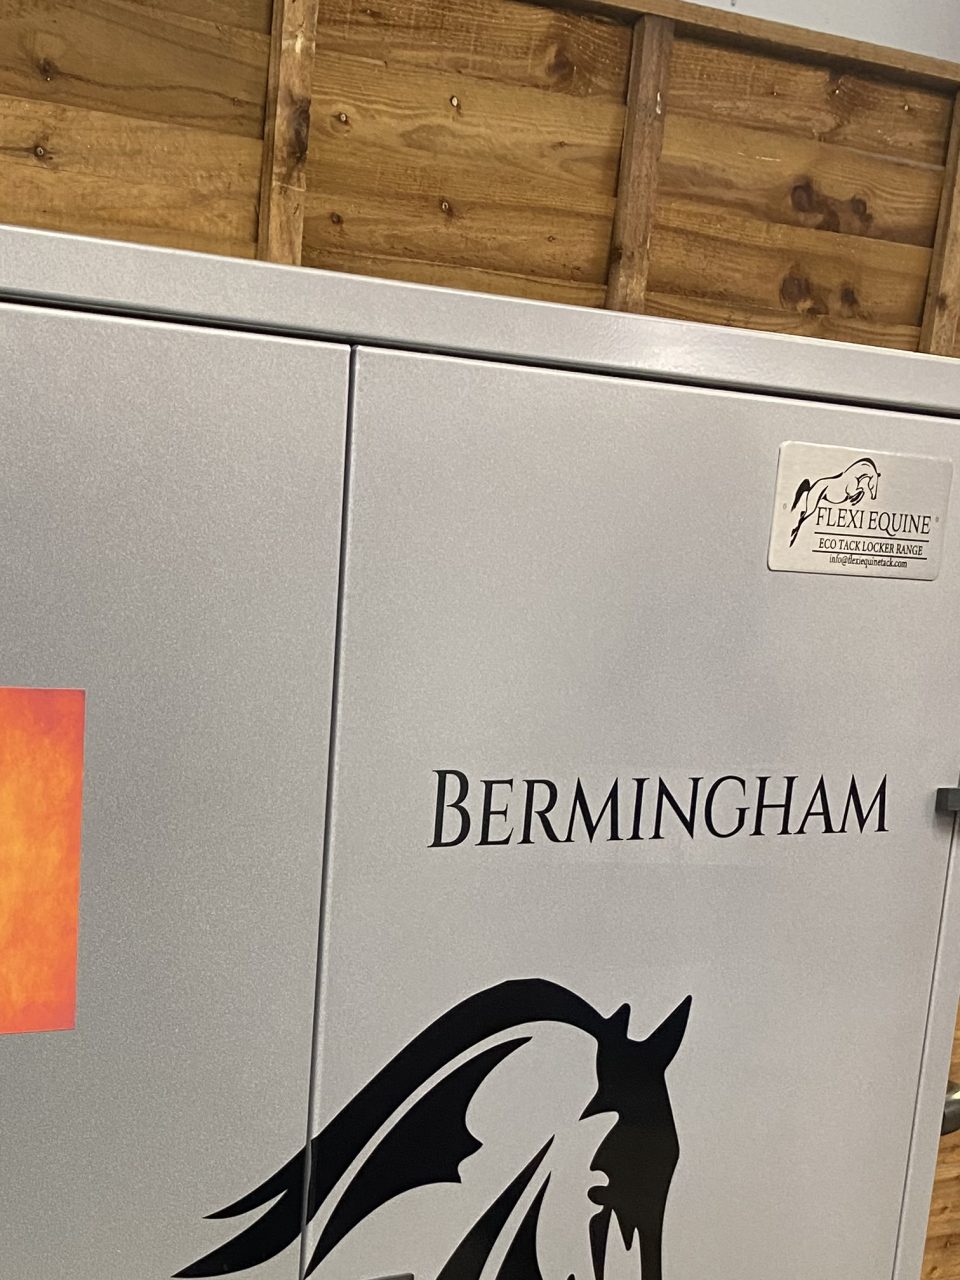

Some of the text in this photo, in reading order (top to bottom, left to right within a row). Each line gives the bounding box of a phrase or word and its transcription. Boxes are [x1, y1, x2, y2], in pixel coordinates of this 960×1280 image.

[816, 507, 931, 536] FLEXI EQUINE
[819, 538, 923, 555] ECO TACK LOCKER RANGE
[829, 554, 908, 568] info@flexiequinetack.com
[427, 769, 889, 849] BERMINGHAM
